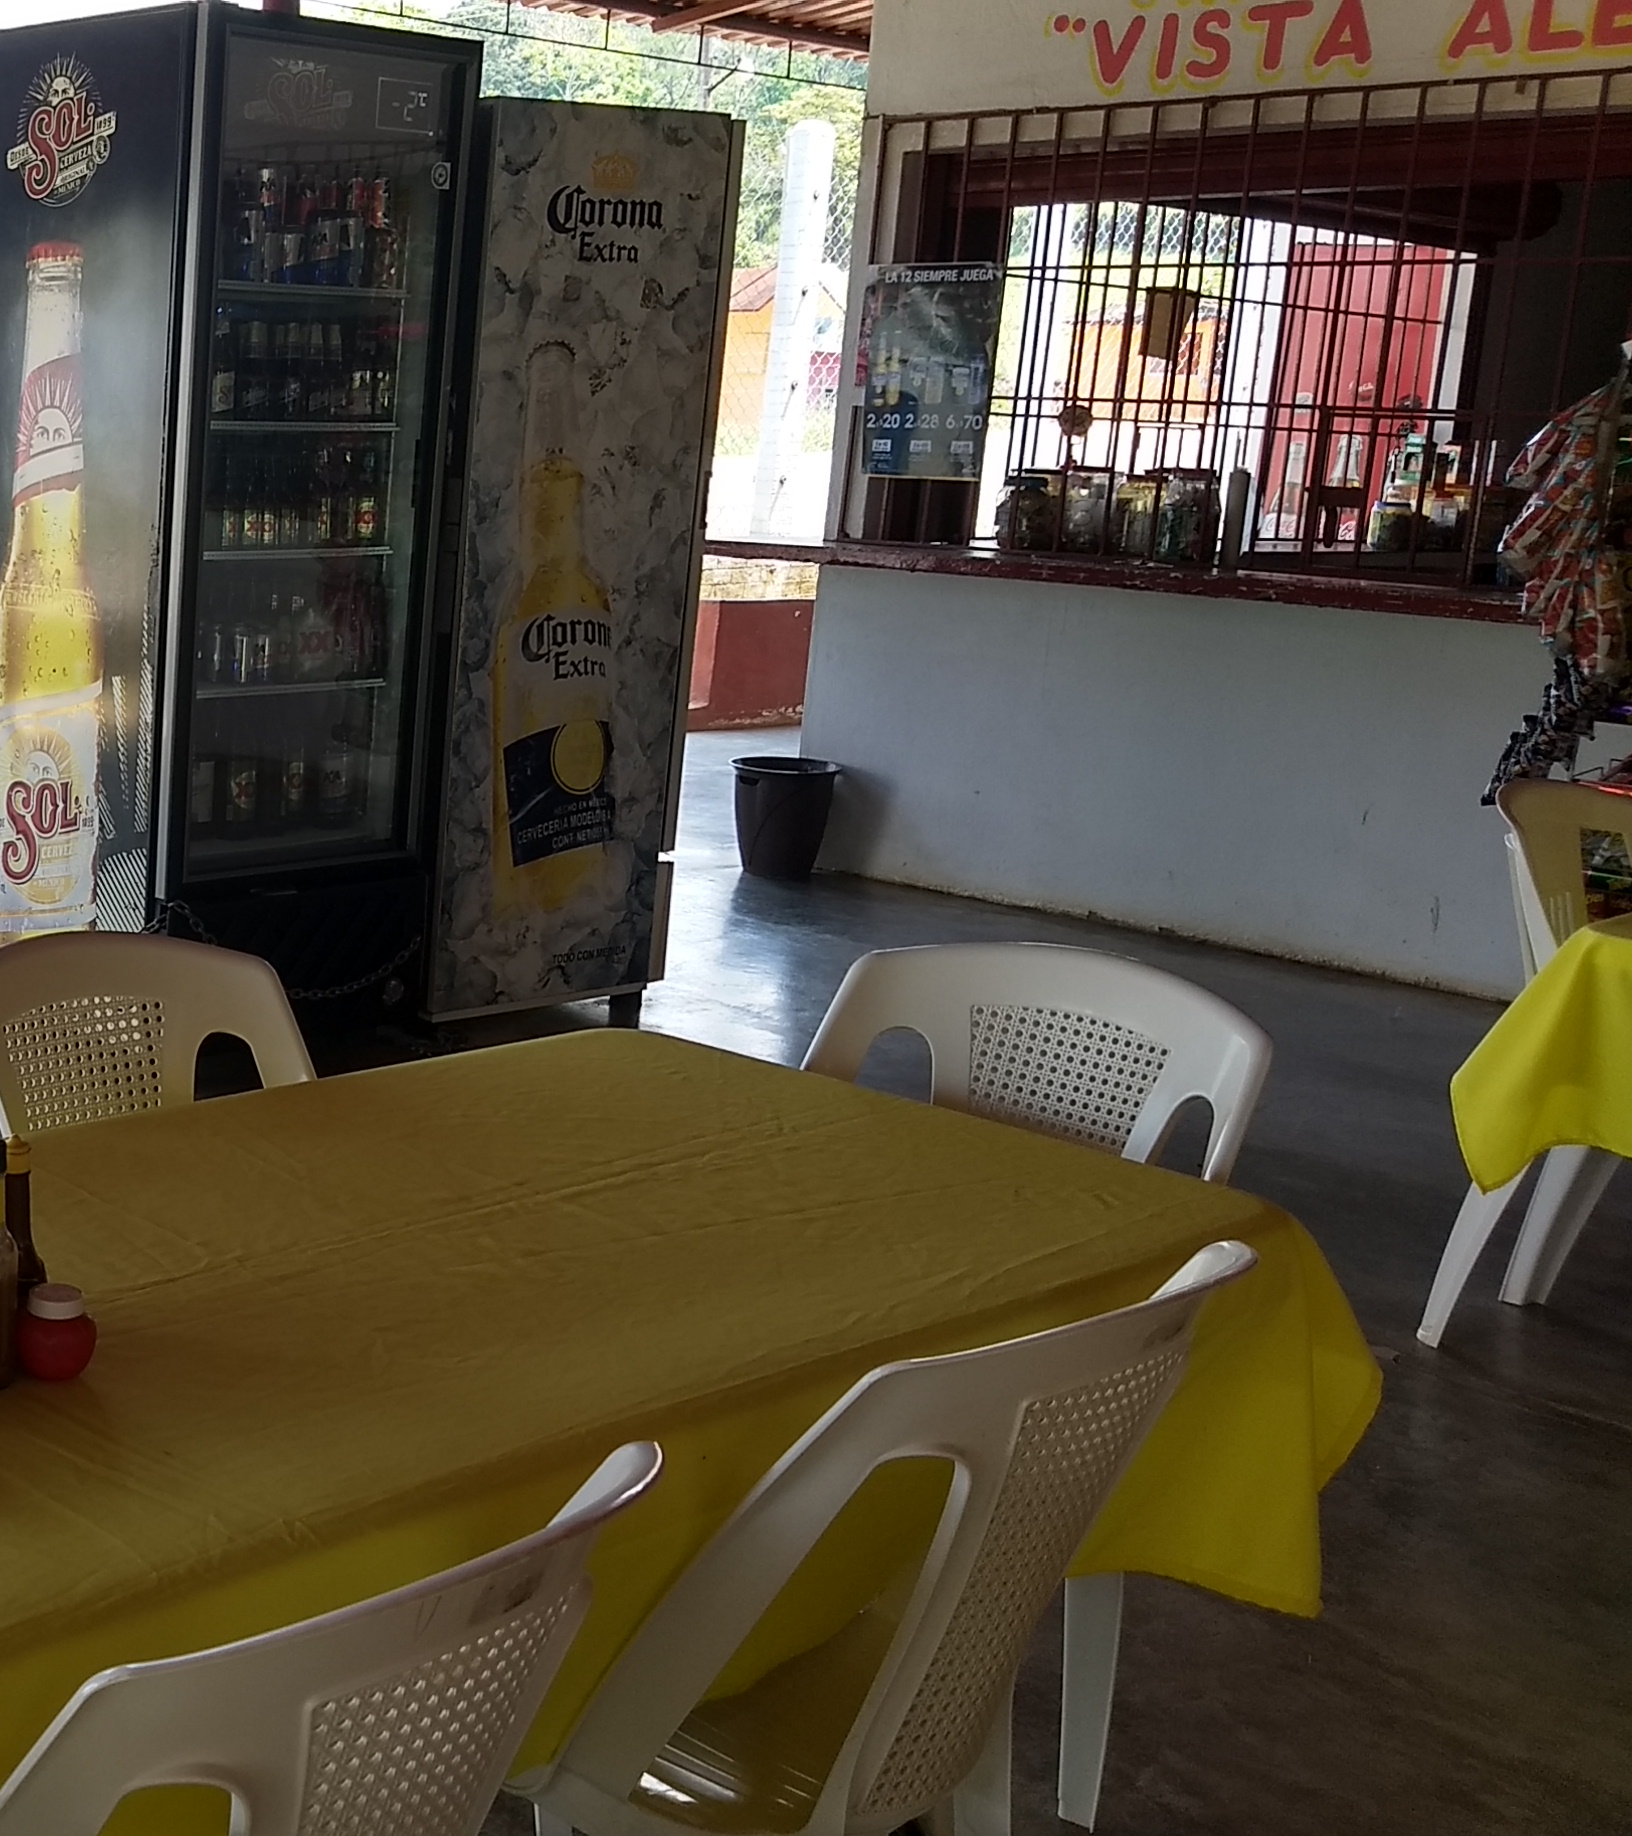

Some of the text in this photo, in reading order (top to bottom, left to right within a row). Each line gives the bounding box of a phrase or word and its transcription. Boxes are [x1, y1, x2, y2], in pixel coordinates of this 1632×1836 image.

[9, 145, 30, 163] DESDE
[24, 91, 94, 199] SOL
[59, 145, 92, 169] CERVEZA
[547, 185, 664, 240] Corona
[577, 231, 639, 264] Extra
[885, 268, 995, 284] LA 12 SIEMPRE JUEGA
[552, 649, 607, 681] Extra
[578, 801, 587, 809] EN
[570, 808, 601, 828] MODELO
[1, 778, 81, 886] SOL
[40, 843, 73, 860] CERVEZ
[552, 952, 575, 965] TODO
[576, 950, 594, 961] CON
